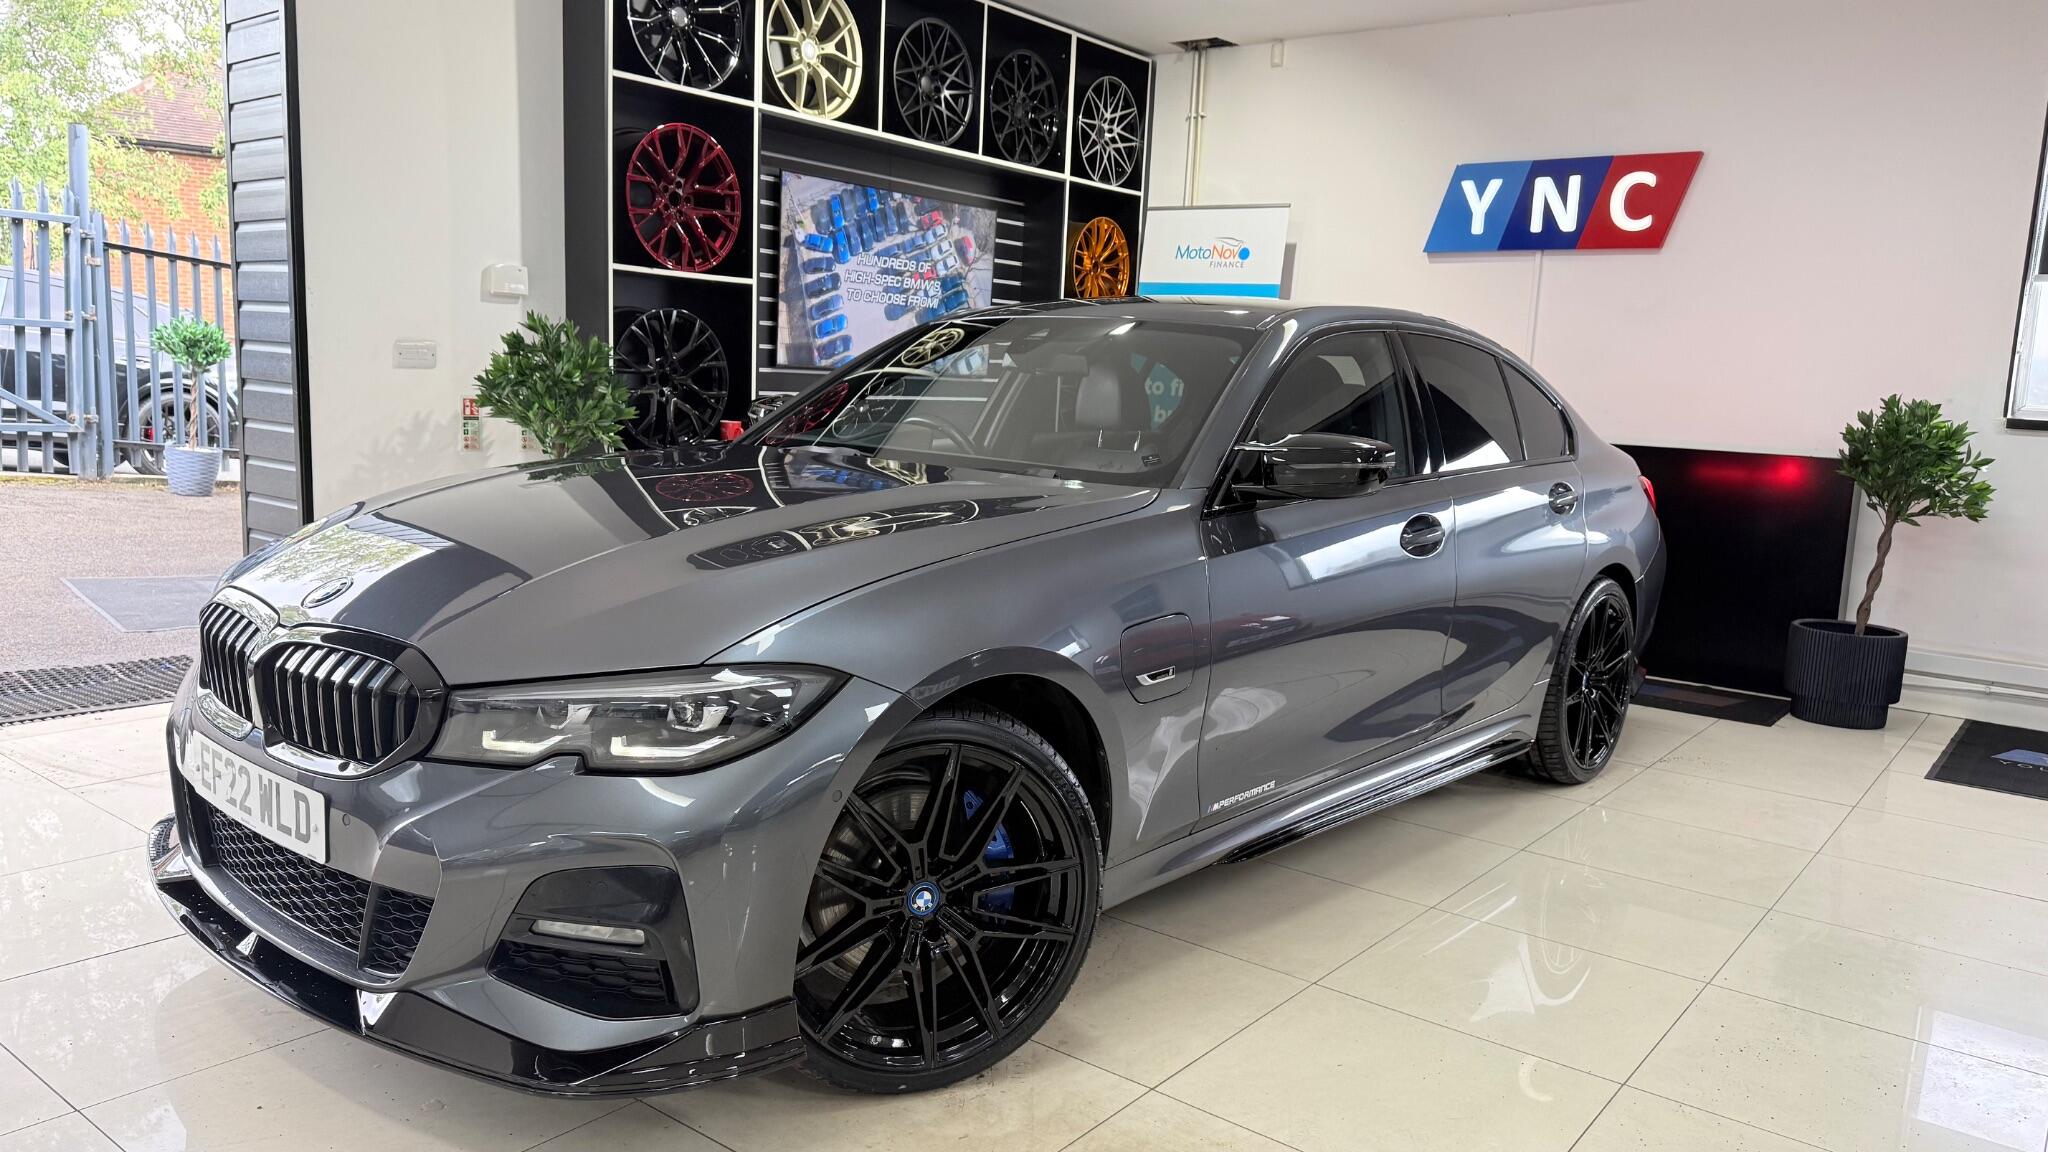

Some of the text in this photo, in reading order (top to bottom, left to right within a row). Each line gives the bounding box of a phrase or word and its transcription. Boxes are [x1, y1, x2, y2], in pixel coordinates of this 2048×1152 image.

[1460, 170, 1658, 236] YNC
[857, 253, 932, 273] HUNDREDS OF
[1175, 244, 1251, 261] MotoNovo
[1209, 261, 1246, 269] FINANCE
[844, 269, 941, 291] HIGH-SPEC BMW'S
[847, 288, 862, 301] TO
[863, 291, 907, 305] CHOOSE
[200, 741, 311, 844] EF22 WLD
[1219, 780, 1276, 809] PERFORMANCE
